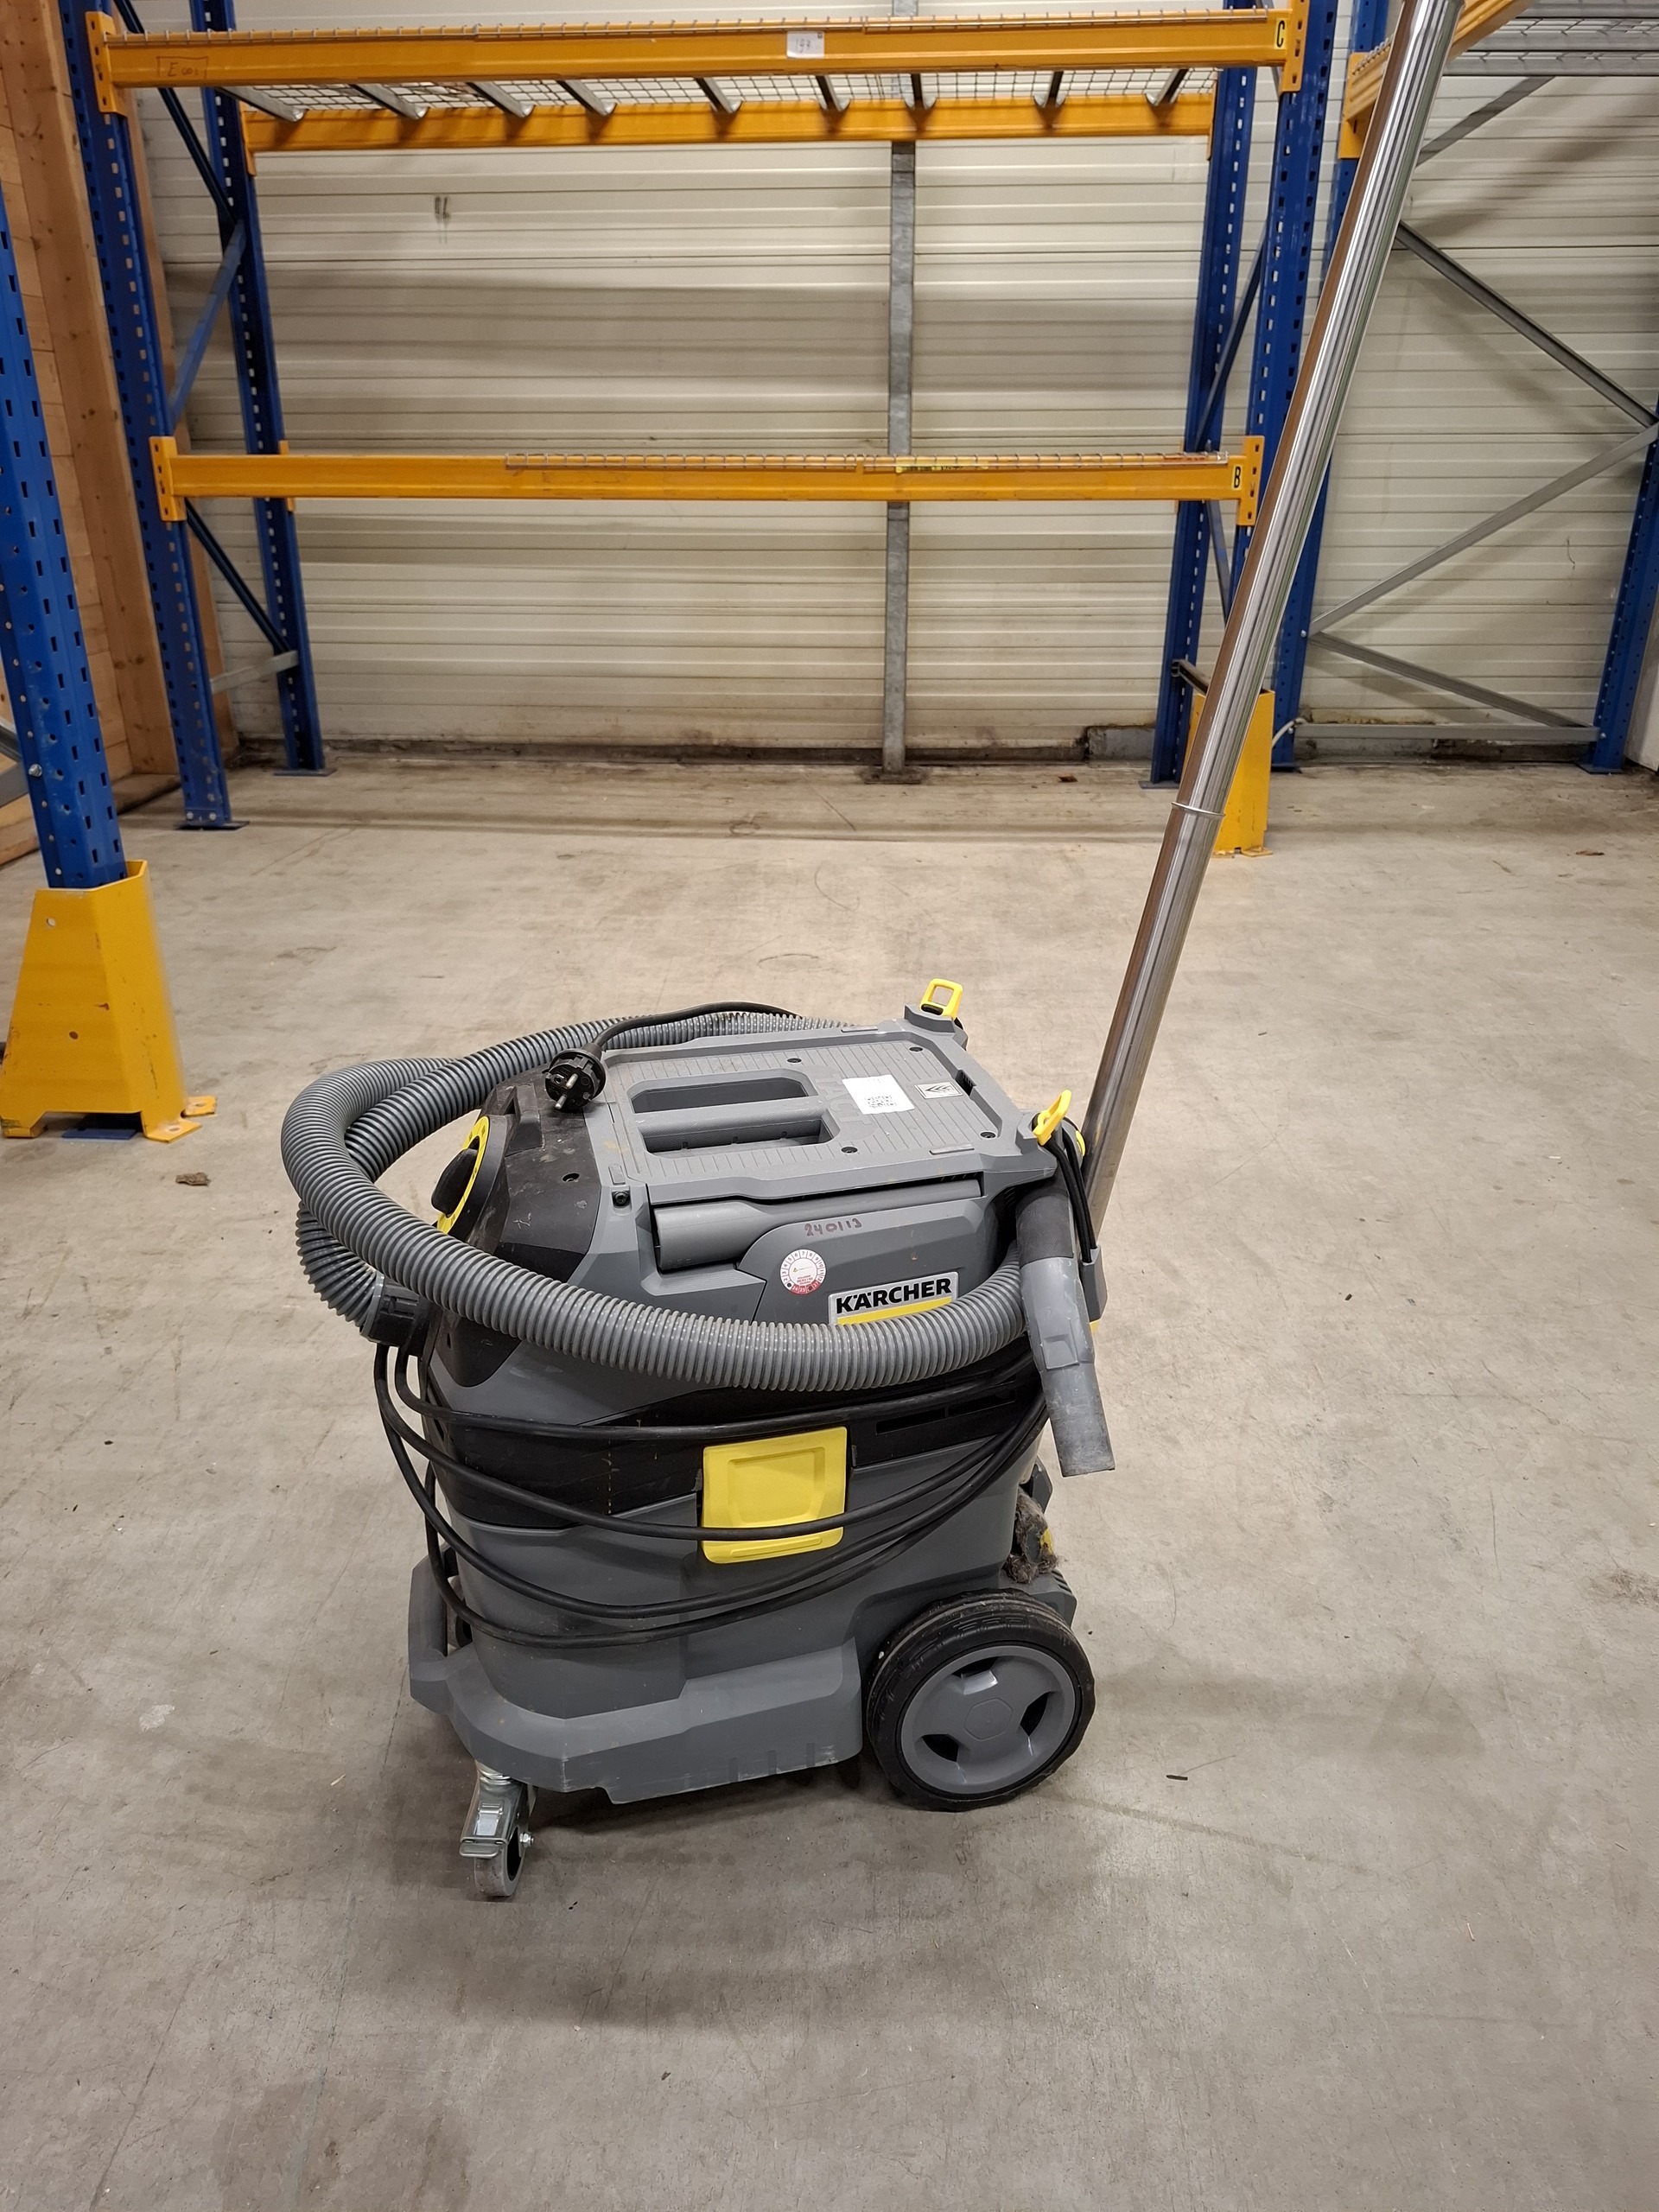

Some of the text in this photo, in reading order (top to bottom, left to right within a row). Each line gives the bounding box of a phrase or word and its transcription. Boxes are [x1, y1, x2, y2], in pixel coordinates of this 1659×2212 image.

[1276, 20, 1286, 48] C
[1234, 466, 1242, 488] B
[804, 1217, 862, 1236] 240113
[836, 1278, 951, 1314] KÄRCHER
